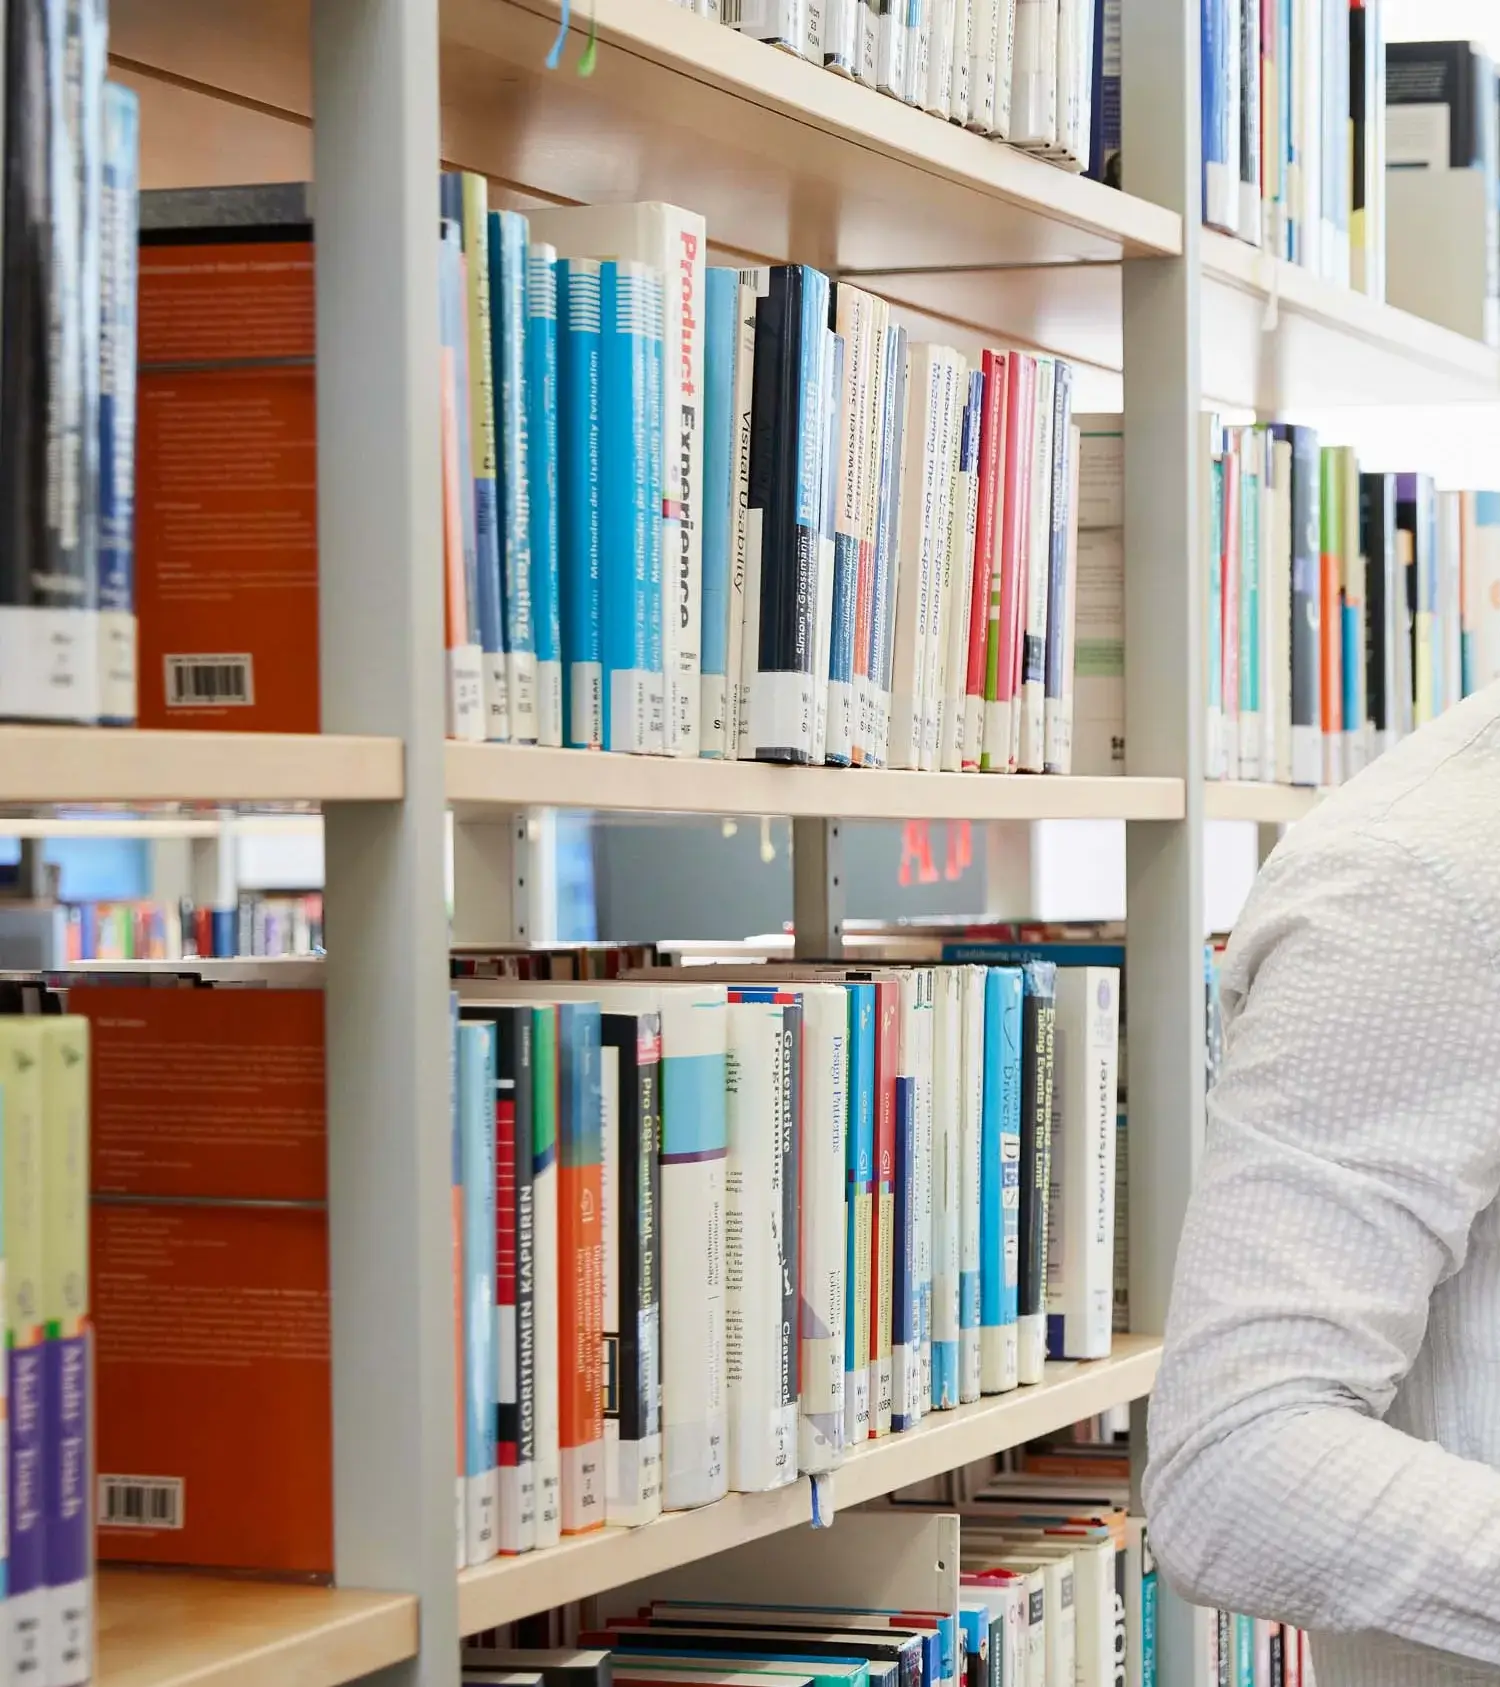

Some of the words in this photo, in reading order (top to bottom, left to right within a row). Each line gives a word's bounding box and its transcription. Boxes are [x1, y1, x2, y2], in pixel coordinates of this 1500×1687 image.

[807, 31, 821, 48] KUN
[810, 20, 818, 32] 23
[680, 231, 698, 397] Product
[588, 351, 599, 421] Evaluation
[926, 361, 941, 453] Measuring
[940, 364, 953, 454] Measuring
[739, 410, 752, 482] Visual
[989, 372, 1002, 465] umsetzen
[588, 426, 600, 484] Usability
[634, 426, 646, 485] Usability
[650, 429, 662, 488] Usability
[844, 413, 857, 520] Praxiswissen
[853, 384, 867, 522] Testmanagement
[927, 459, 936, 487] the
[951, 449, 959, 473] the
[589, 486, 599, 507] der
[633, 488, 646, 509] der
[650, 490, 661, 512] der
[680, 404, 697, 629] Experience
[925, 492, 934, 529] User
[937, 493, 946, 535] User
[948, 476, 958, 505] User
[984, 470, 996, 559] praktisch
[589, 510, 600, 580] Methoden
[635, 511, 647, 581] Methoden
[650, 514, 662, 583] Methoden
[733, 490, 749, 594] Usability
[797, 535, 808, 604] Grossmann
[943, 510, 956, 589] Experience
[918, 536, 932, 635] Experience
[931, 539, 944, 637] Experience
[796, 616, 806, 655] Simon
[831, 1036, 844, 1086] Design
[1036, 1008, 1047, 1053] Taking
[642, 1077, 653, 1109] Pro
[772, 1030, 783, 1191] Programming
[782, 1029, 793, 1154] Generative
[1002, 1065, 1014, 1127] Driven
[1035, 1056, 1046, 1105] Events
[642, 1115, 654, 1153] CSS
[831, 1091, 843, 1156] Patterns
[1035, 1107, 1045, 1122] to
[1035, 1125, 1044, 1149] the
[1034, 1151, 1044, 1189] Limit
[1096, 1058, 1108, 1244] Entwurfsmuster
[518, 1184, 533, 1293] KAPIEREN
[642, 1191, 653, 1241] HTML
[829, 1271, 837, 1325] Johnson
[519, 1301, 534, 1458] ALGORITHMEN
[782, 1320, 791, 1405] Czarneck
